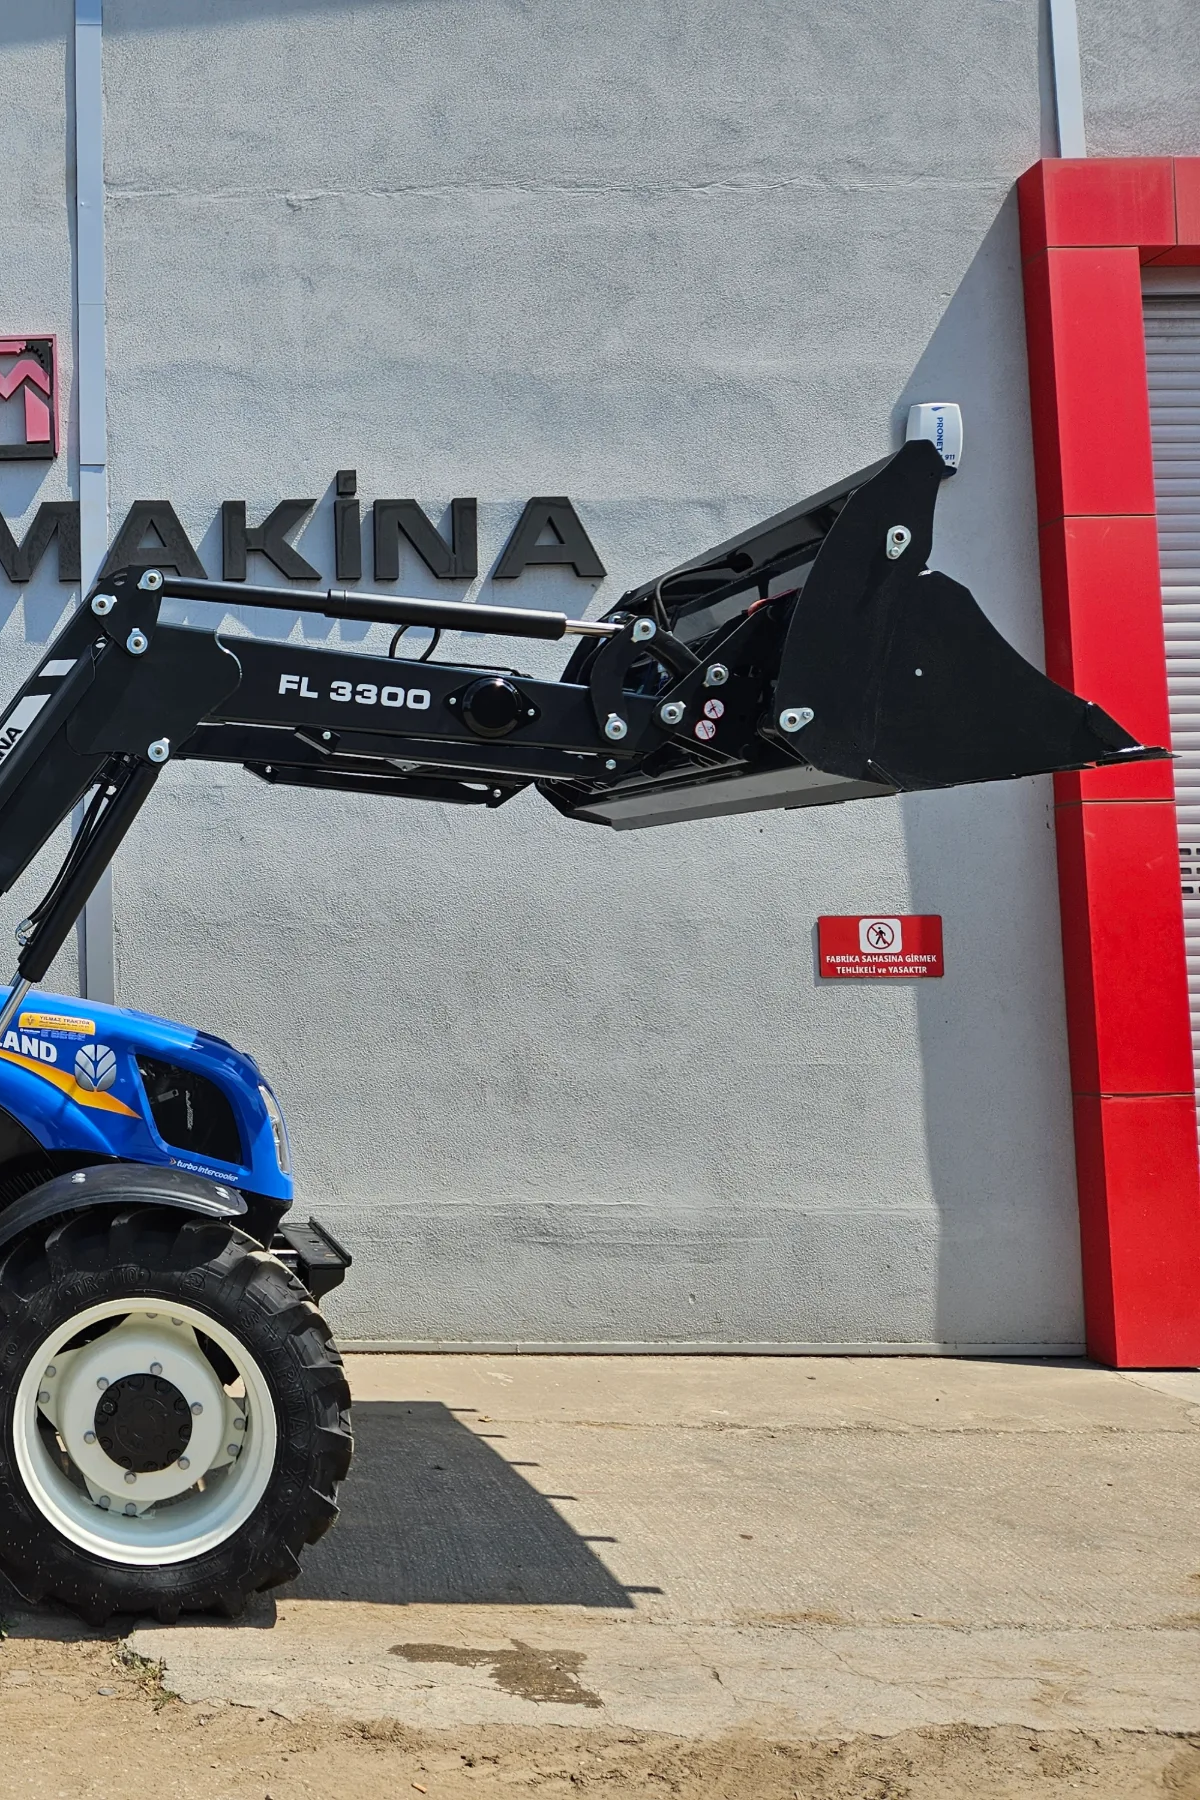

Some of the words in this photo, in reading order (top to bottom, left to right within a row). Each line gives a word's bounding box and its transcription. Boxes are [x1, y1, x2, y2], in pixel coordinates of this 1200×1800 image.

[936, 416, 944, 452] PRONET
[278, 674, 318, 699] FL
[329, 680, 431, 710] 3300
[826, 954, 860, 963] FABRİKA
[862, 955, 903, 963] SAHASINA
[905, 953, 937, 963] GİRMEK
[836, 965, 876, 974] TEHLİKELİ
[888, 966, 928, 974] YASAKTIR
[176, 1159, 198, 1171] turbo
[197, 1165, 239, 1182] intercooler
